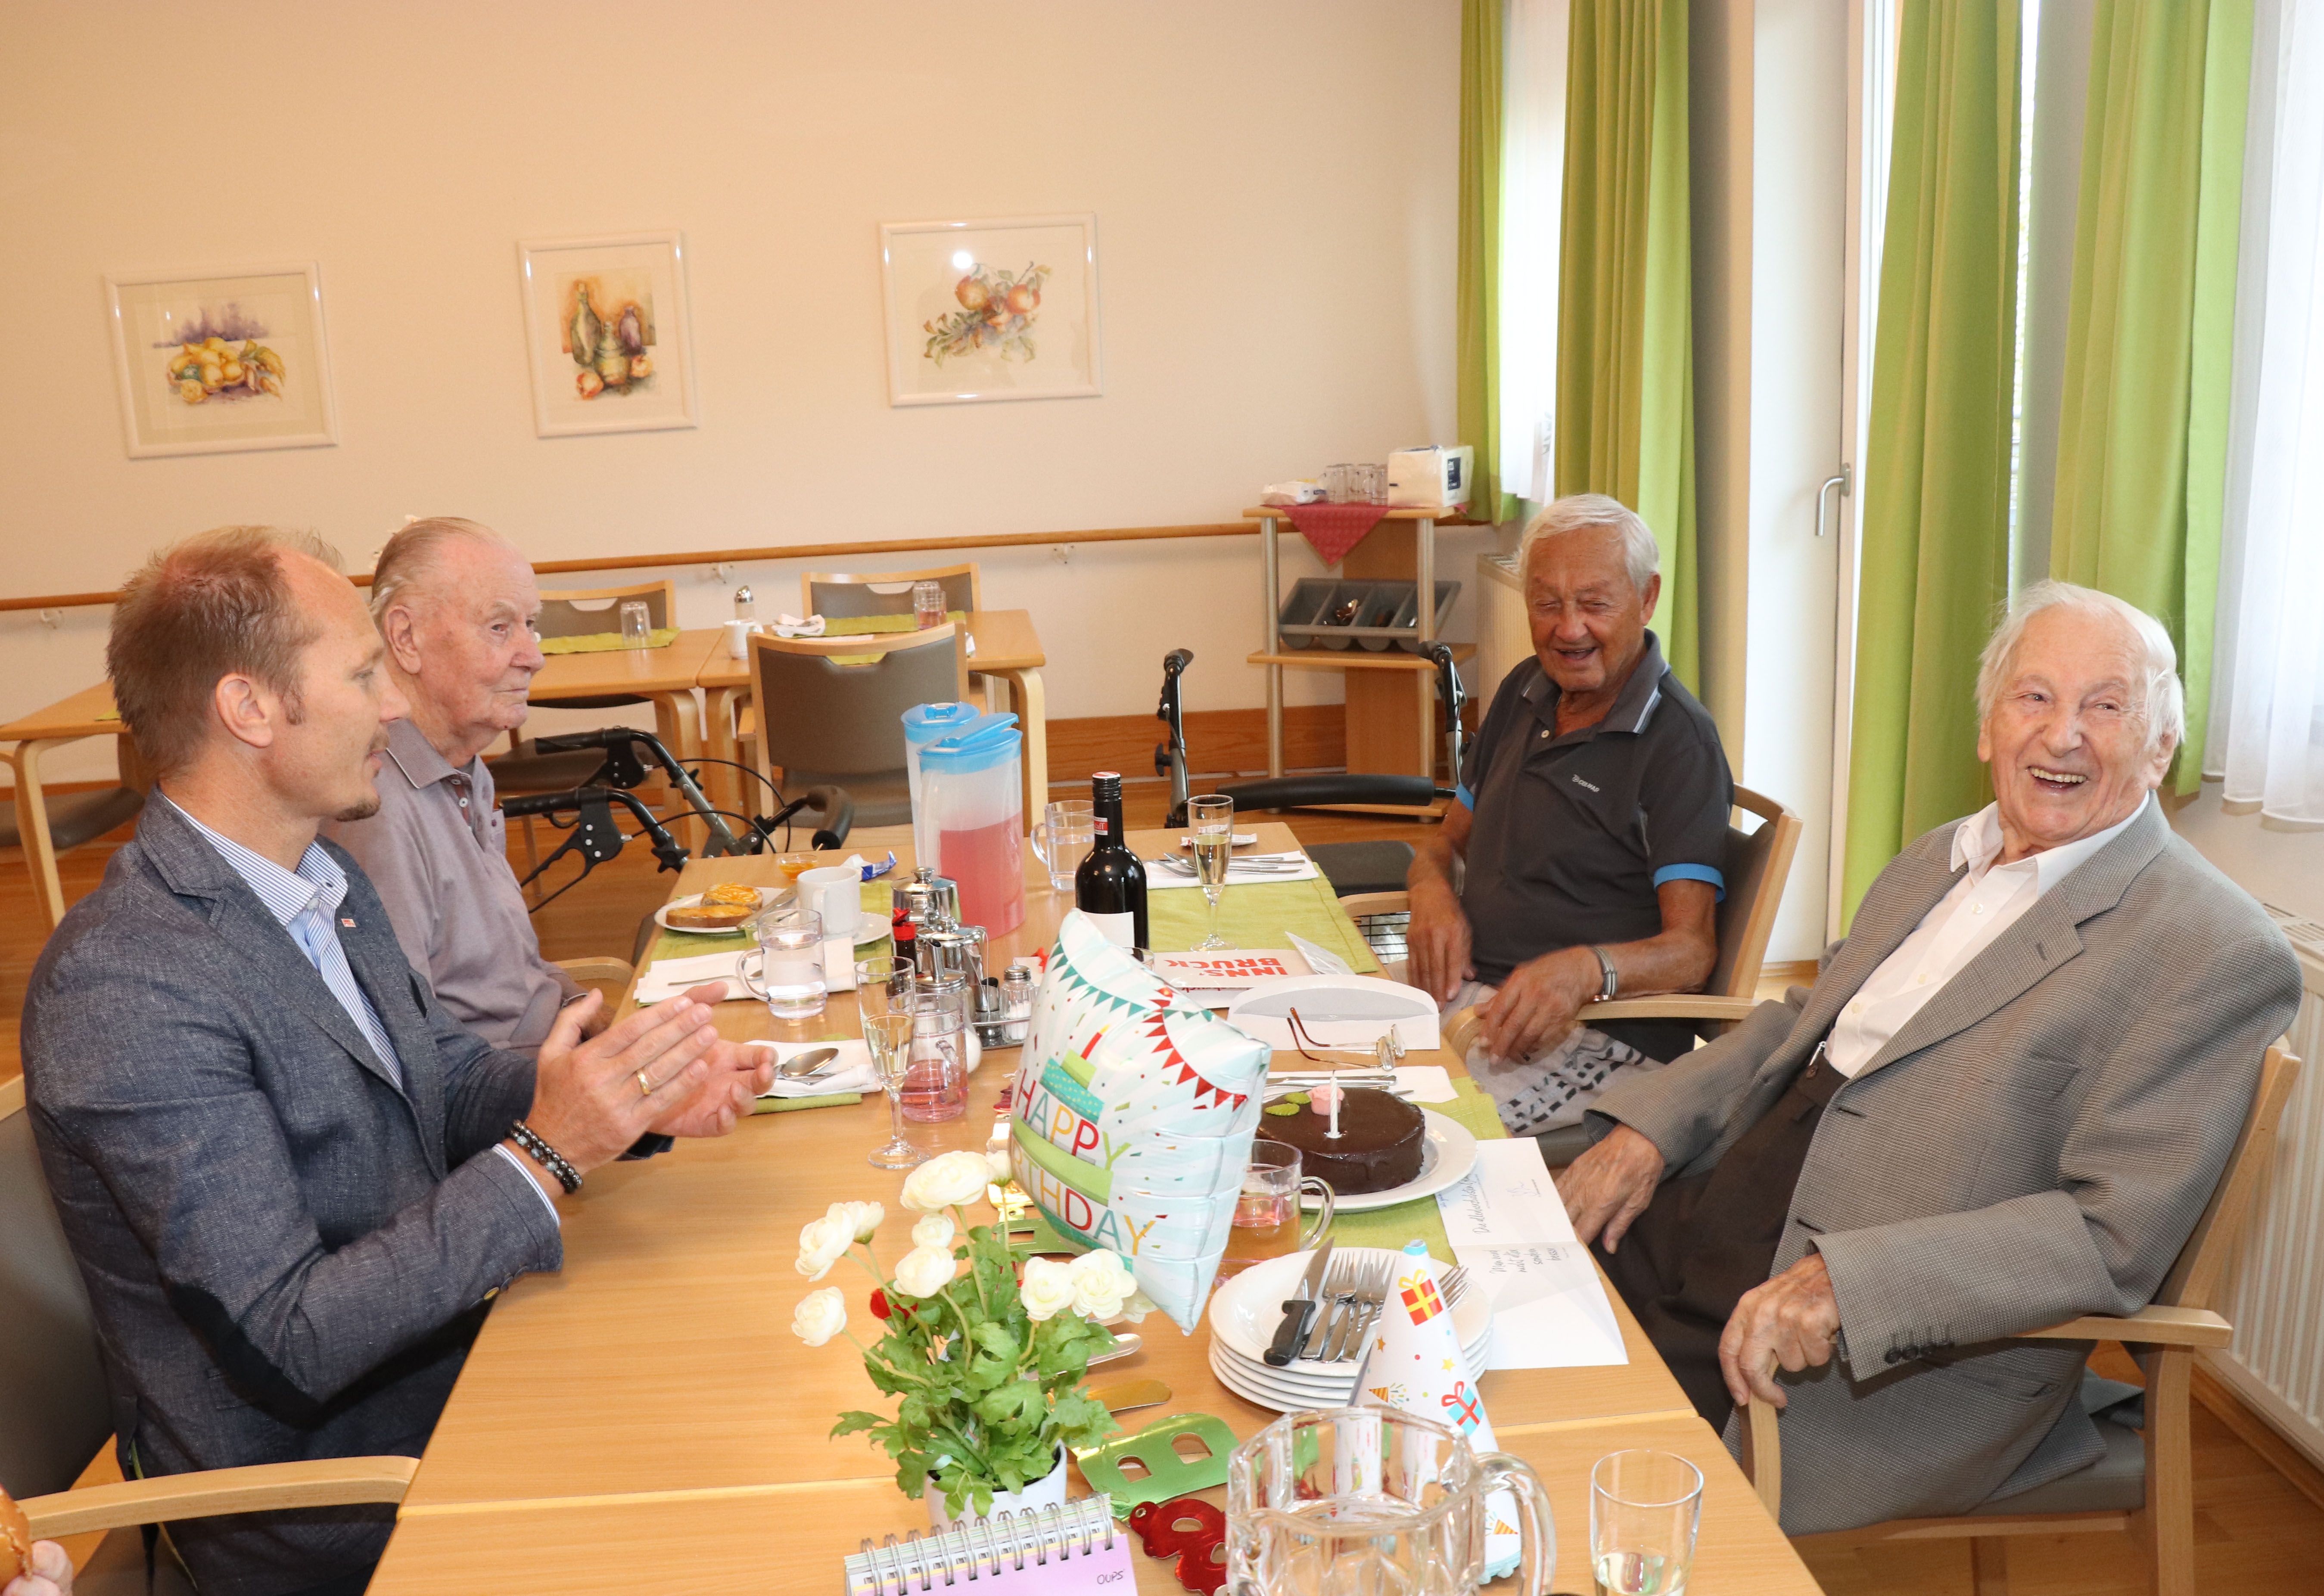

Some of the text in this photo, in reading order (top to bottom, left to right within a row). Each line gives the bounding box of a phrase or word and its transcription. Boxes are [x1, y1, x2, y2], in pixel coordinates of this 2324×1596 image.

[1164, 958, 1282, 969] BRUCK
[1014, 1068, 1132, 1171] HAPPY
[1097, 1571, 1123, 1584] OUPS
